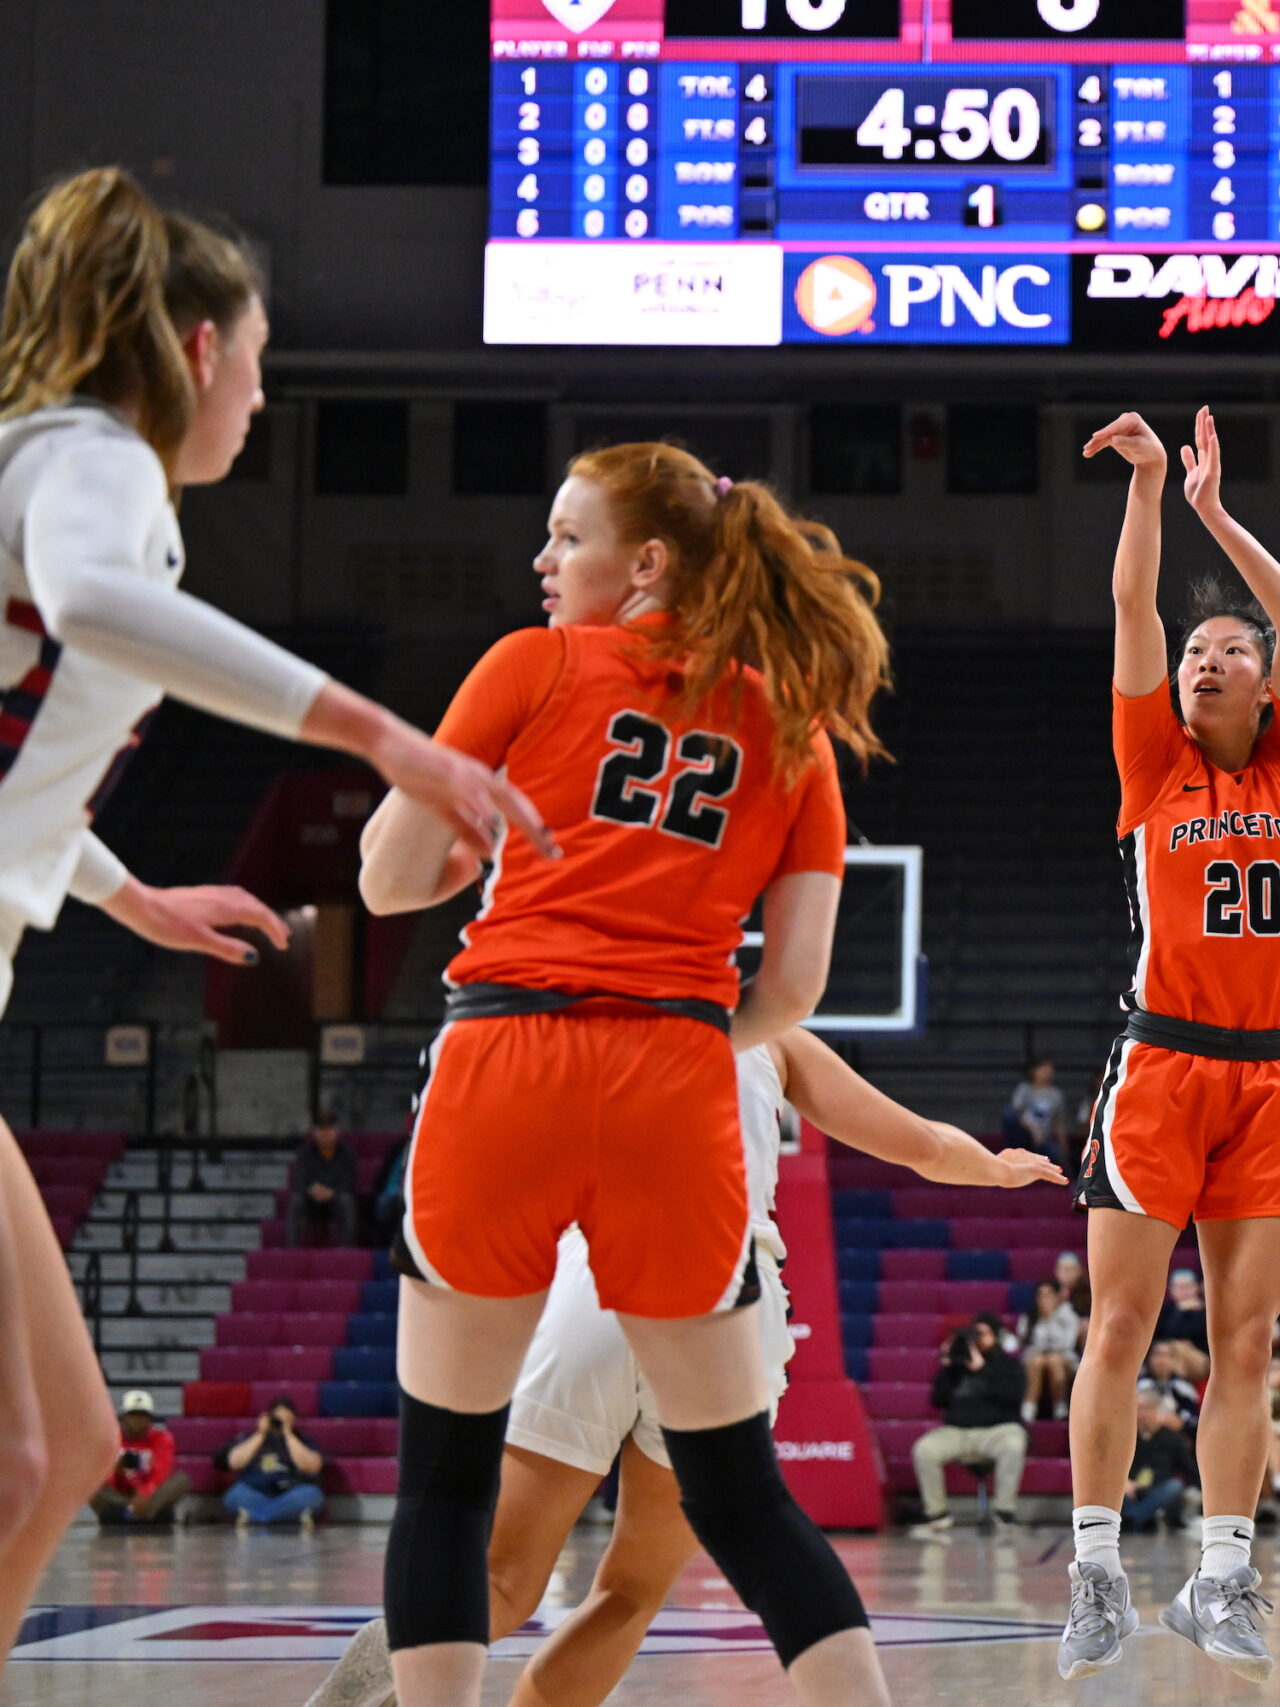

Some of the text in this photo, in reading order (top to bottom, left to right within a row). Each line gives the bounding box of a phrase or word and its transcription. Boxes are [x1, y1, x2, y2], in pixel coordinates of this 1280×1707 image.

[521, 67, 648, 96] 1 0 0
[745, 74, 768, 102] 4
[1079, 76, 1101, 103] 4
[1213, 70, 1232, 98] 1
[518, 102, 648, 131] 2 0 0
[744, 117, 767, 145] 4
[856, 87, 1041, 161] 4:50
[1213, 105, 1235, 134] 2
[1079, 118, 1102, 147] 2
[518, 137, 648, 166] 3 0 0
[1213, 141, 1235, 169] 3
[516, 173, 648, 203] 4 0 0
[1211, 177, 1235, 205] 4
[864, 184, 995, 228] QTR 1
[516, 208, 648, 239] 5 0 0
[633, 273, 723, 298] PENN
[882, 264, 1052, 329] PNC
[589, 708, 744, 851] 22
